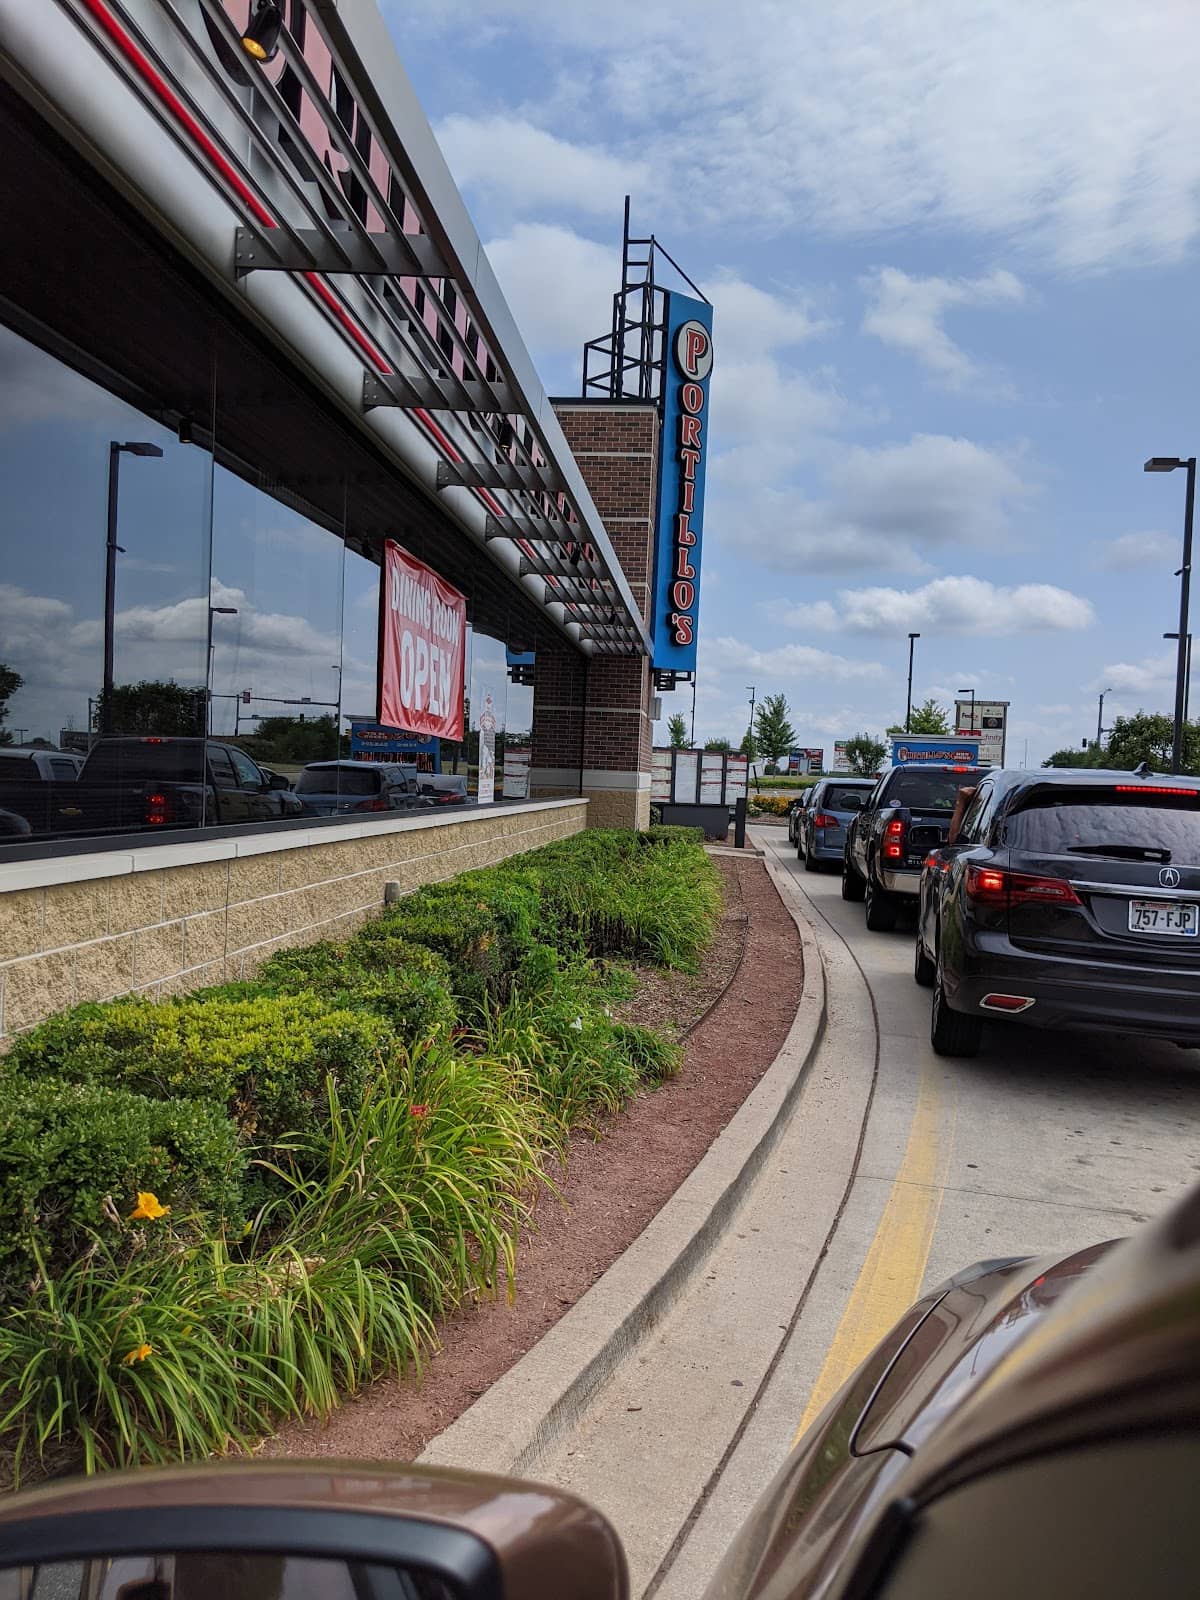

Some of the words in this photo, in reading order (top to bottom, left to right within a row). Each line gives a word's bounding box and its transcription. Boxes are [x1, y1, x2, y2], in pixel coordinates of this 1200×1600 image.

[671, 327, 707, 646] PORTILLO'S
[392, 566, 431, 630] DINING
[433, 597, 460, 647] ROOM
[401, 630, 451, 720] OPEN
[1136, 909, 1190, 928] 757-FJP
